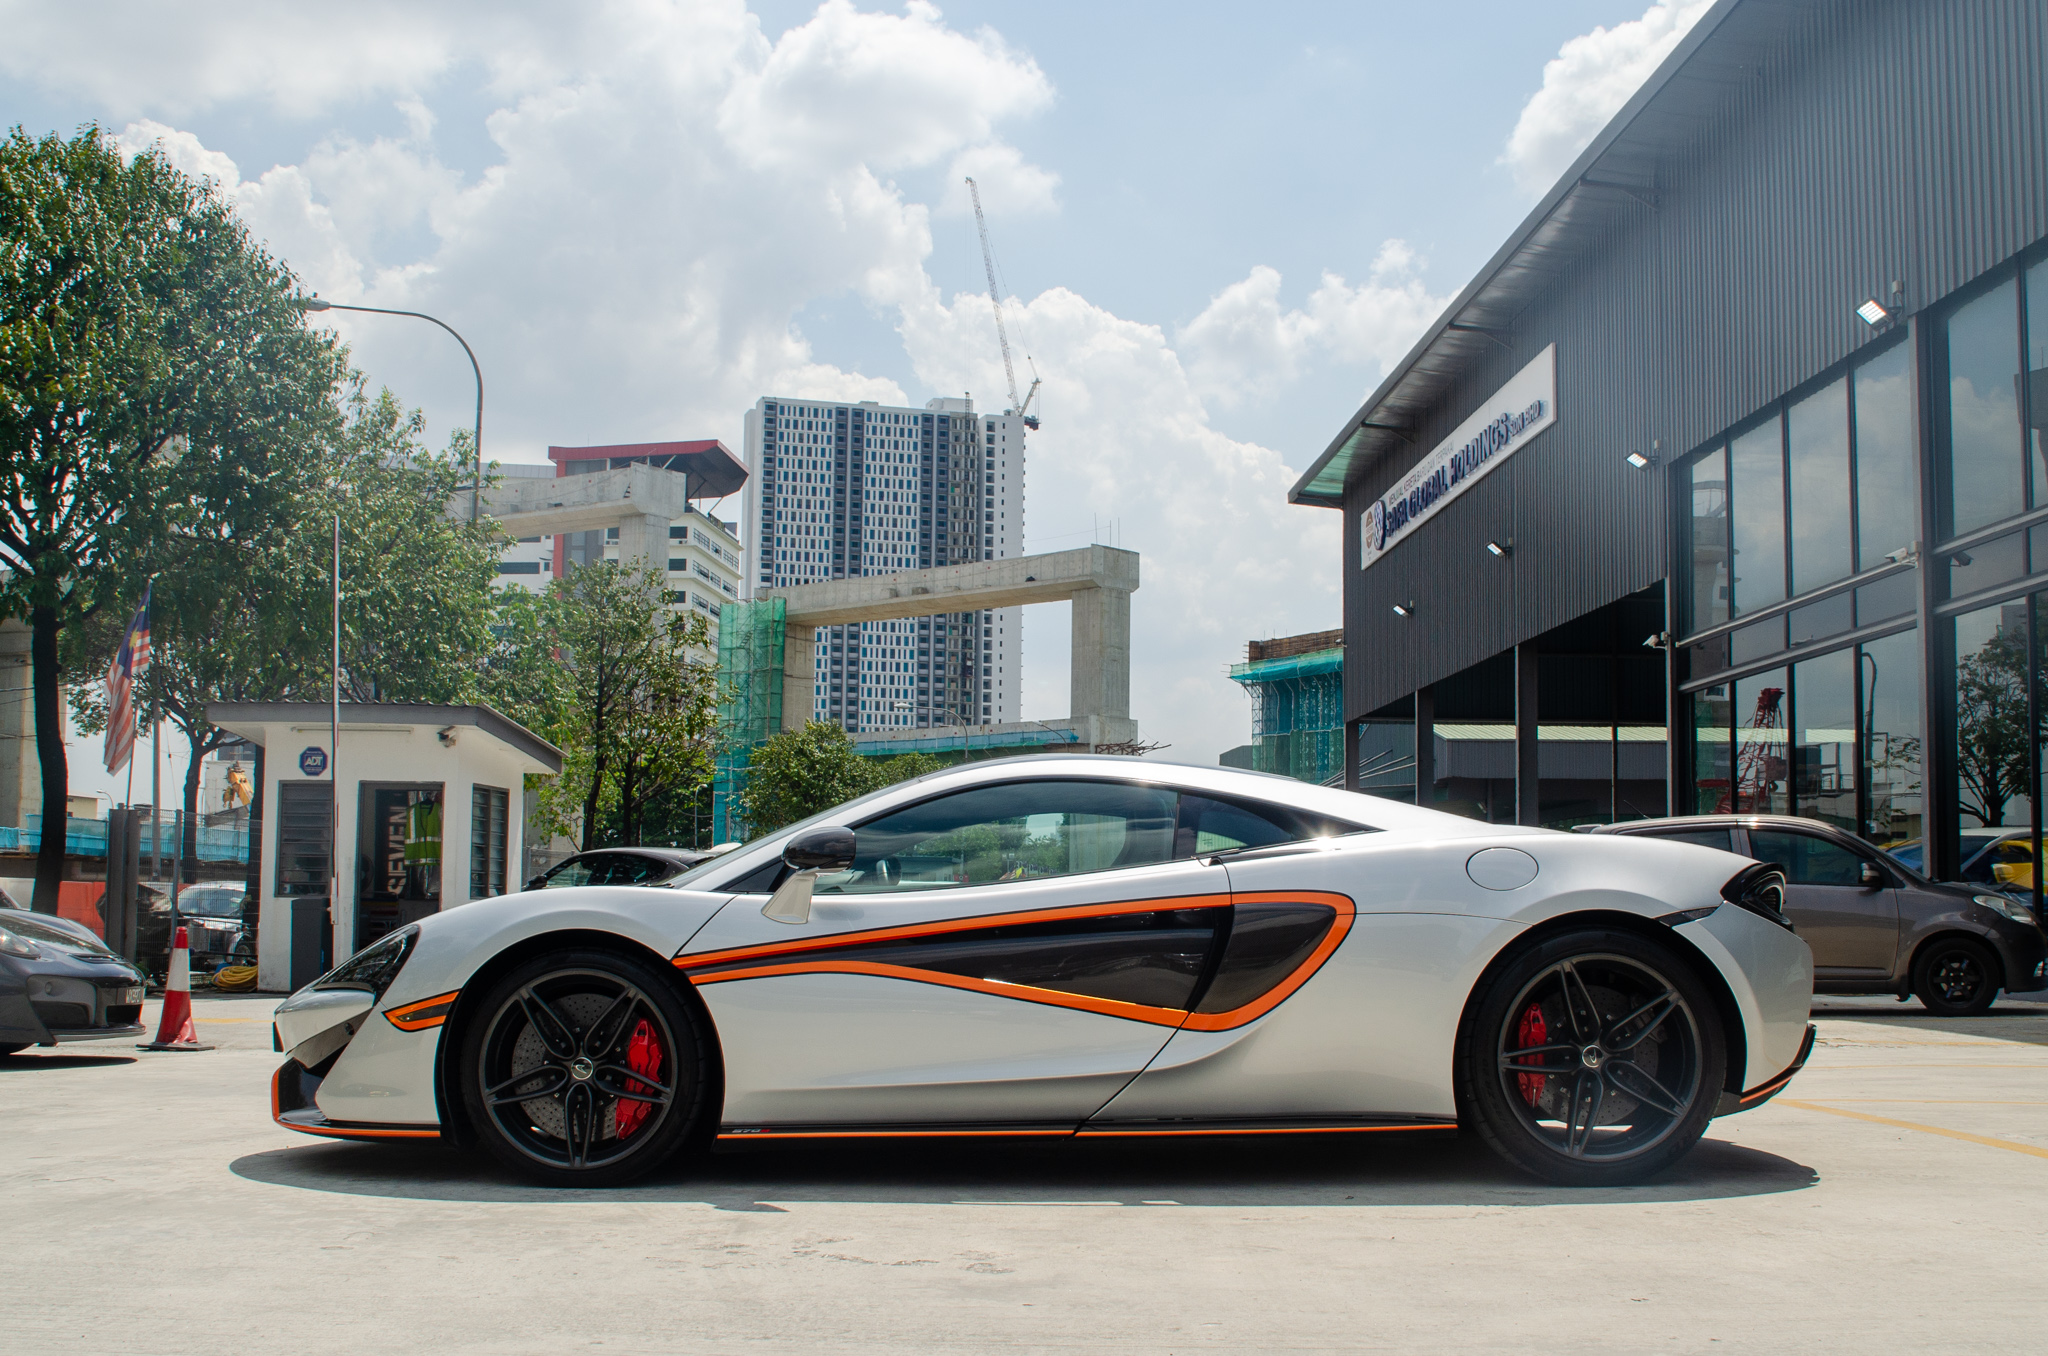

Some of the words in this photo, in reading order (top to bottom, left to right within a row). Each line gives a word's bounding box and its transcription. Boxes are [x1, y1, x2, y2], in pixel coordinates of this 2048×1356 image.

[1409, 465, 1448, 518] GLOBAL
[1449, 412, 1509, 487] HOLDINGS
[1509, 411, 1525, 437] SDN
[1525, 399, 1542, 428] BHD
[305, 756, 323, 766] ADT
[388, 806, 407, 895] SEVEN
